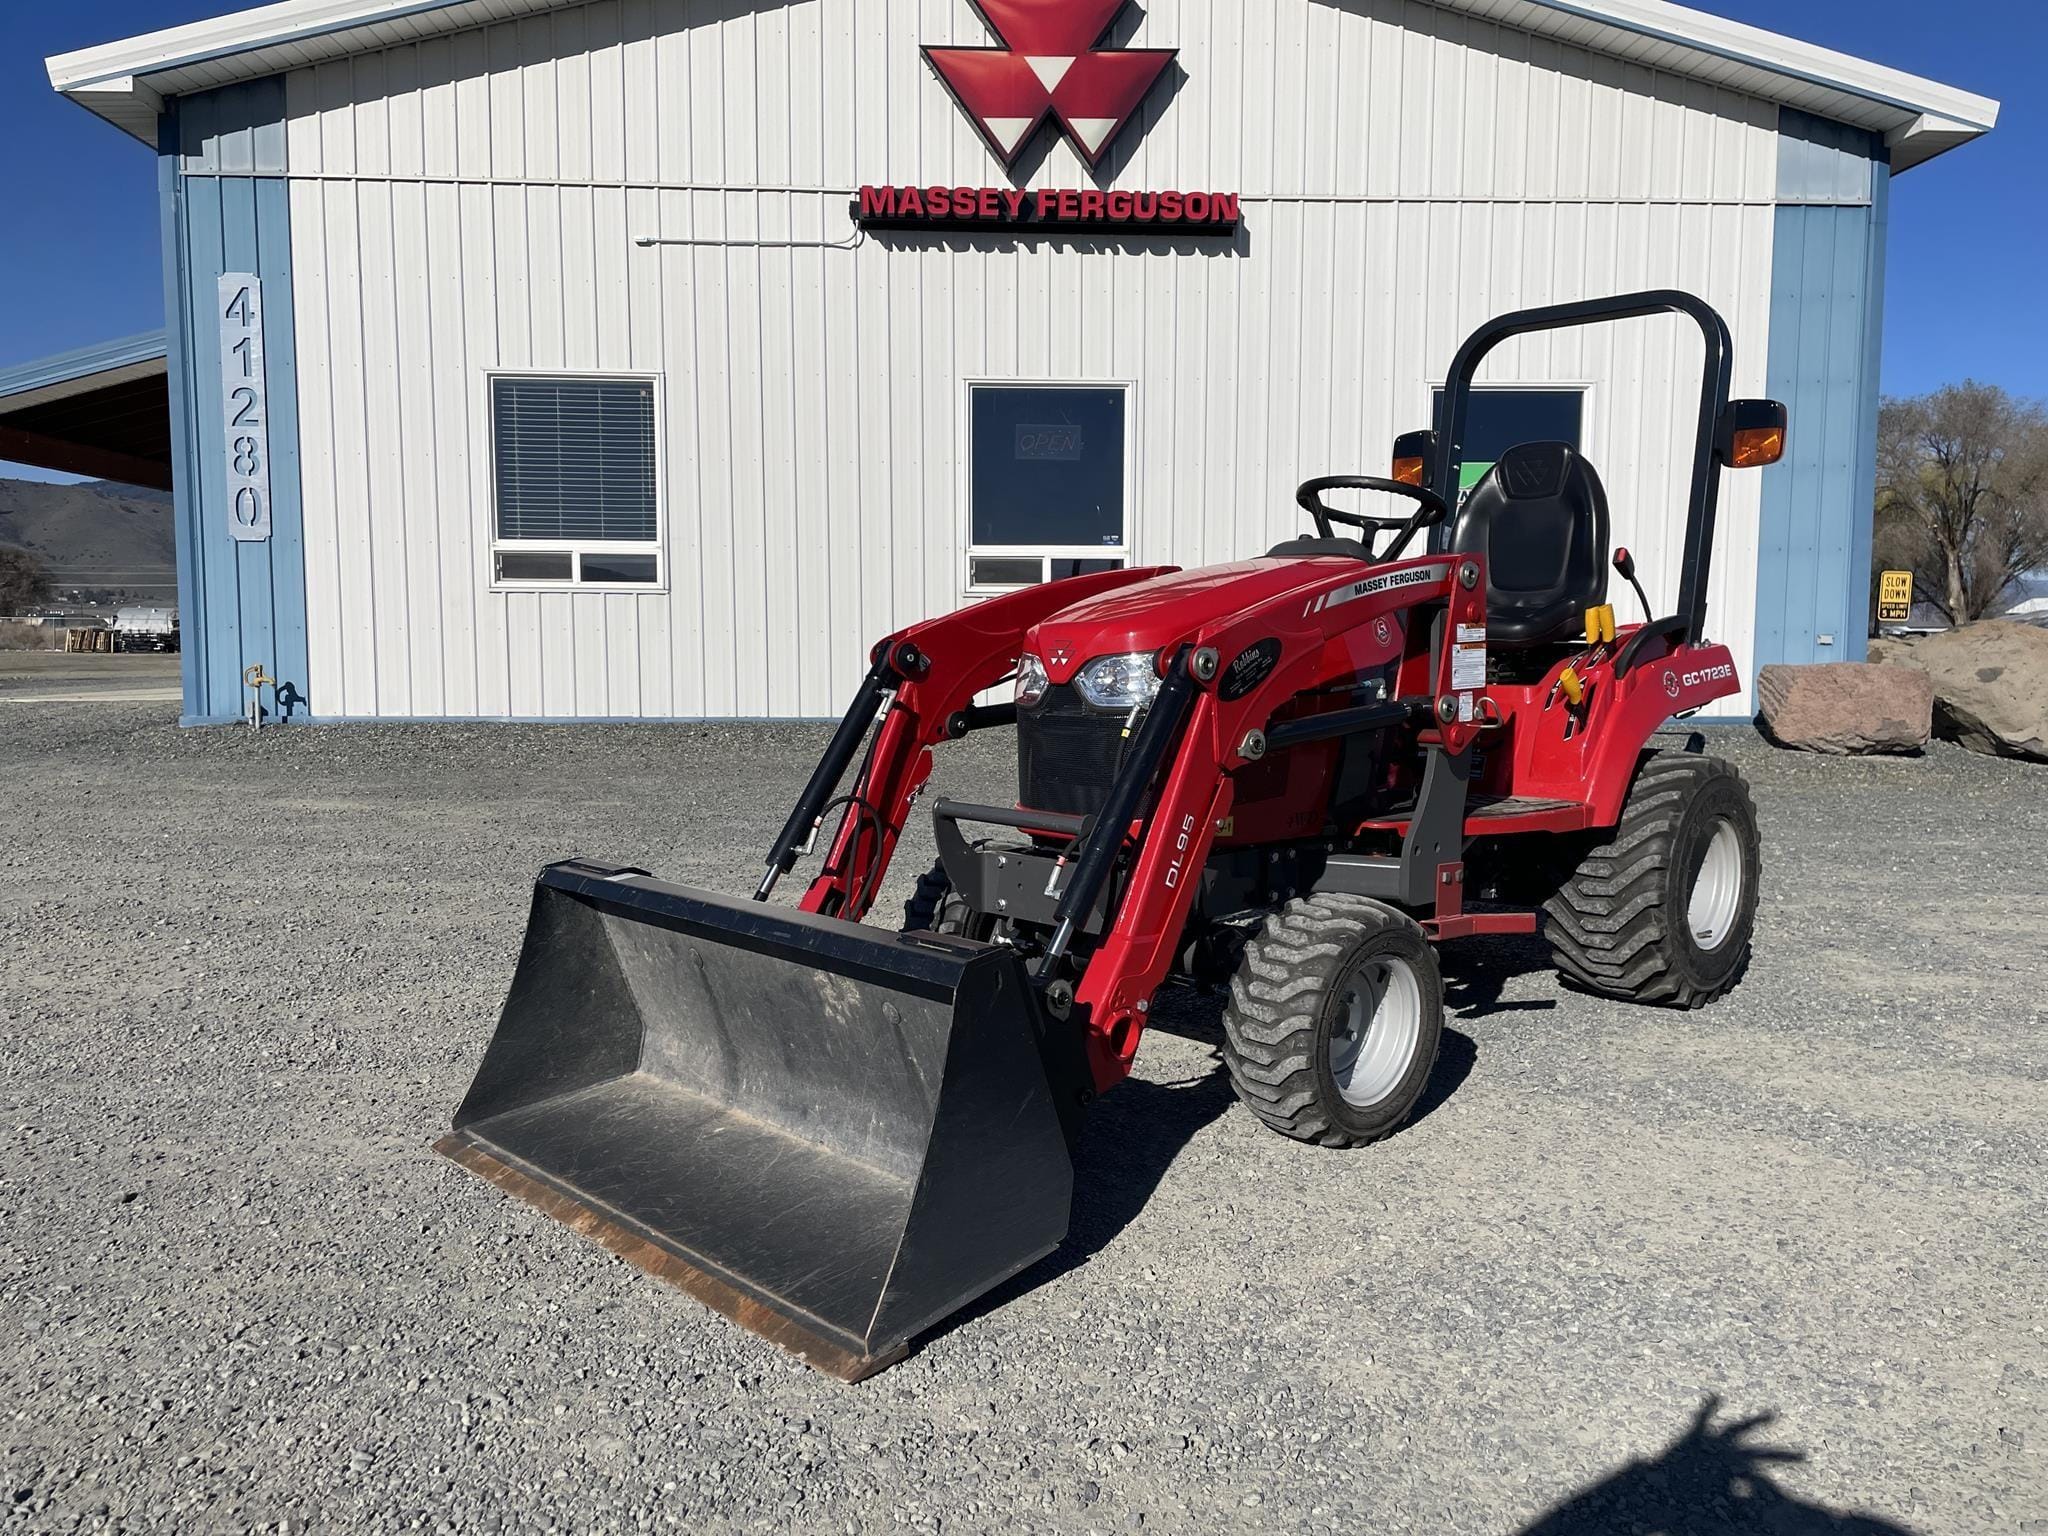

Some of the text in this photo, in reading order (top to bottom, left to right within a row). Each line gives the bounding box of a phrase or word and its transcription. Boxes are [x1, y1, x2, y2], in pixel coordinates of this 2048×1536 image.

[859, 185, 1239, 223] MASSEY FERGUSON
[225, 286, 262, 527] 41280
[1020, 431, 1074, 451] OPEN
[1354, 569, 1431, 596] MASSEY FERGUSON
[1886, 577, 1908, 587] SLOW
[1885, 589, 1907, 599] DOWN
[1890, 609, 1906, 617] MPH
[1682, 664, 1732, 687] GC1723E
[1164, 813, 1195, 889] DL95
